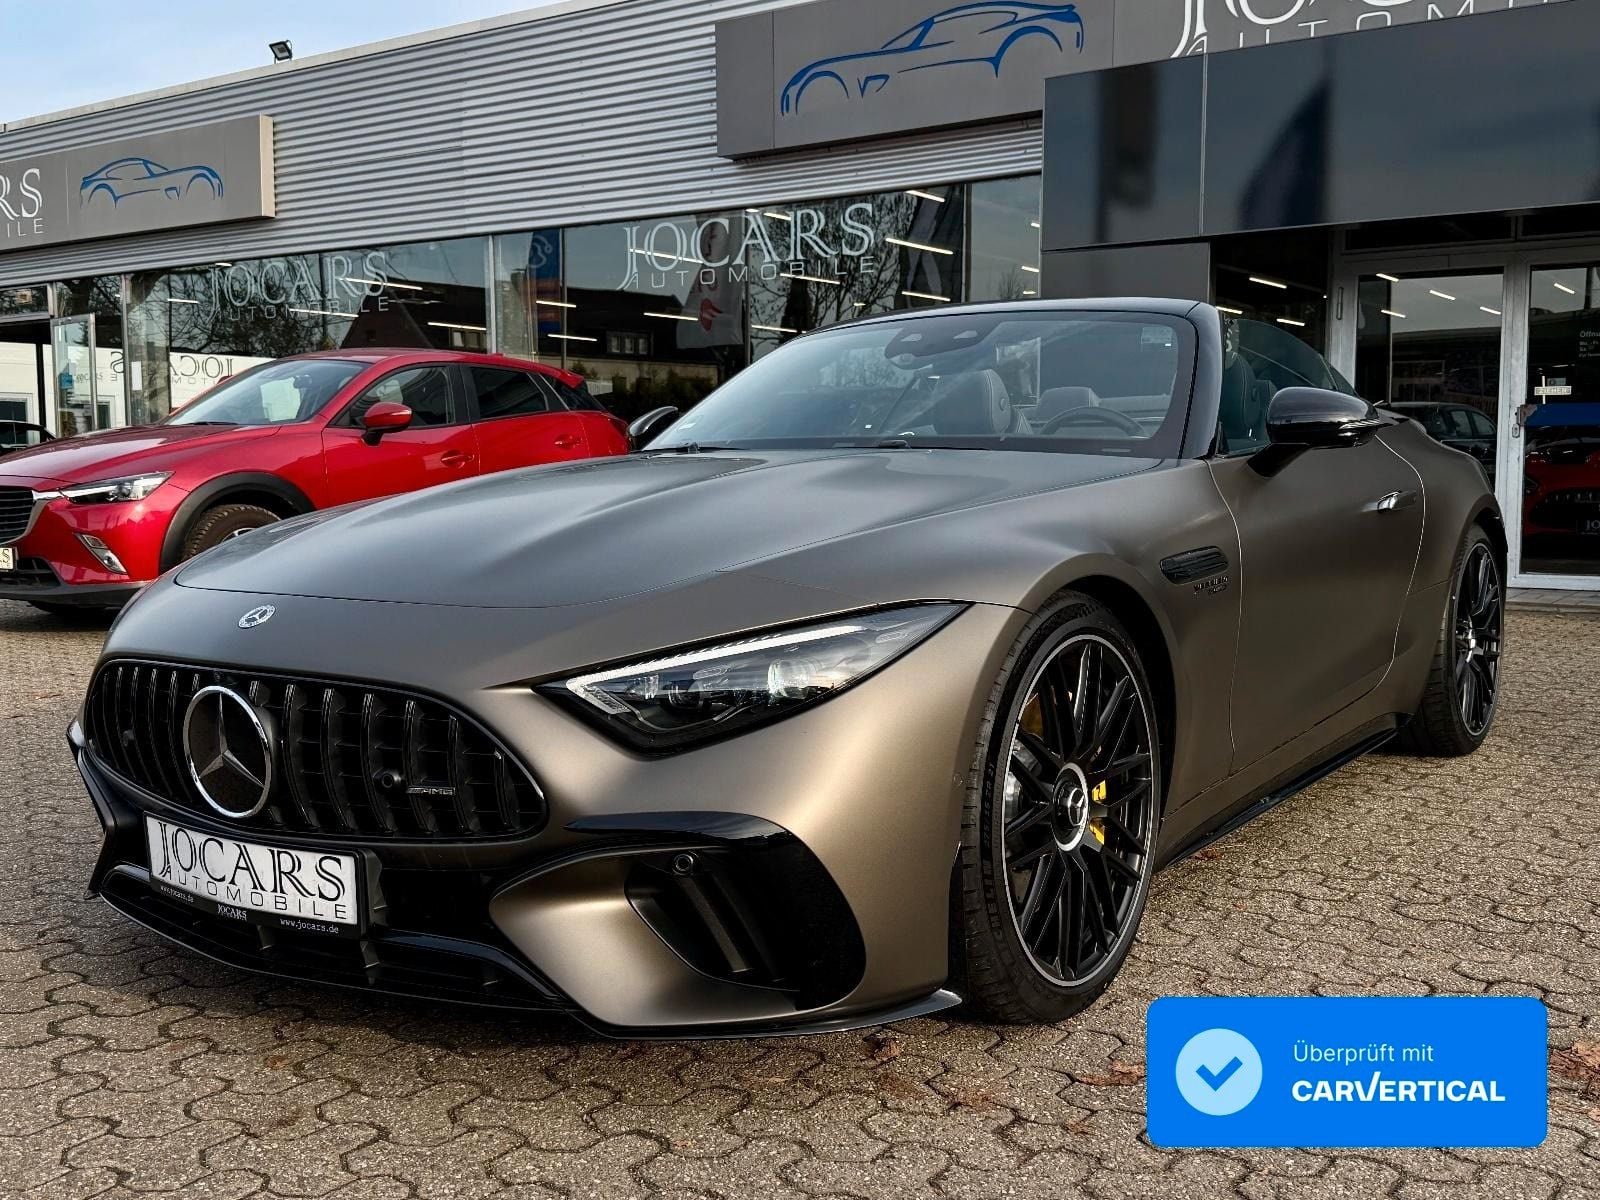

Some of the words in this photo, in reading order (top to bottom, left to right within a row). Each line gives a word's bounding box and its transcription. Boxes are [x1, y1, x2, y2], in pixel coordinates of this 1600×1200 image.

[616, 202, 876, 291] JOCARS
[206, 252, 387, 324] JOCARS
[629, 255, 875, 291] AUTOMOBILE
[215, 297, 388, 321] AUTOMOBILE
[422, 788, 452, 796] AMG
[158, 821, 346, 902] JOCARS
[164, 864, 347, 920] AUTOMOBILE
[217, 904, 247, 918] JOCARS
[280, 917, 339, 934] www.jocars.de
